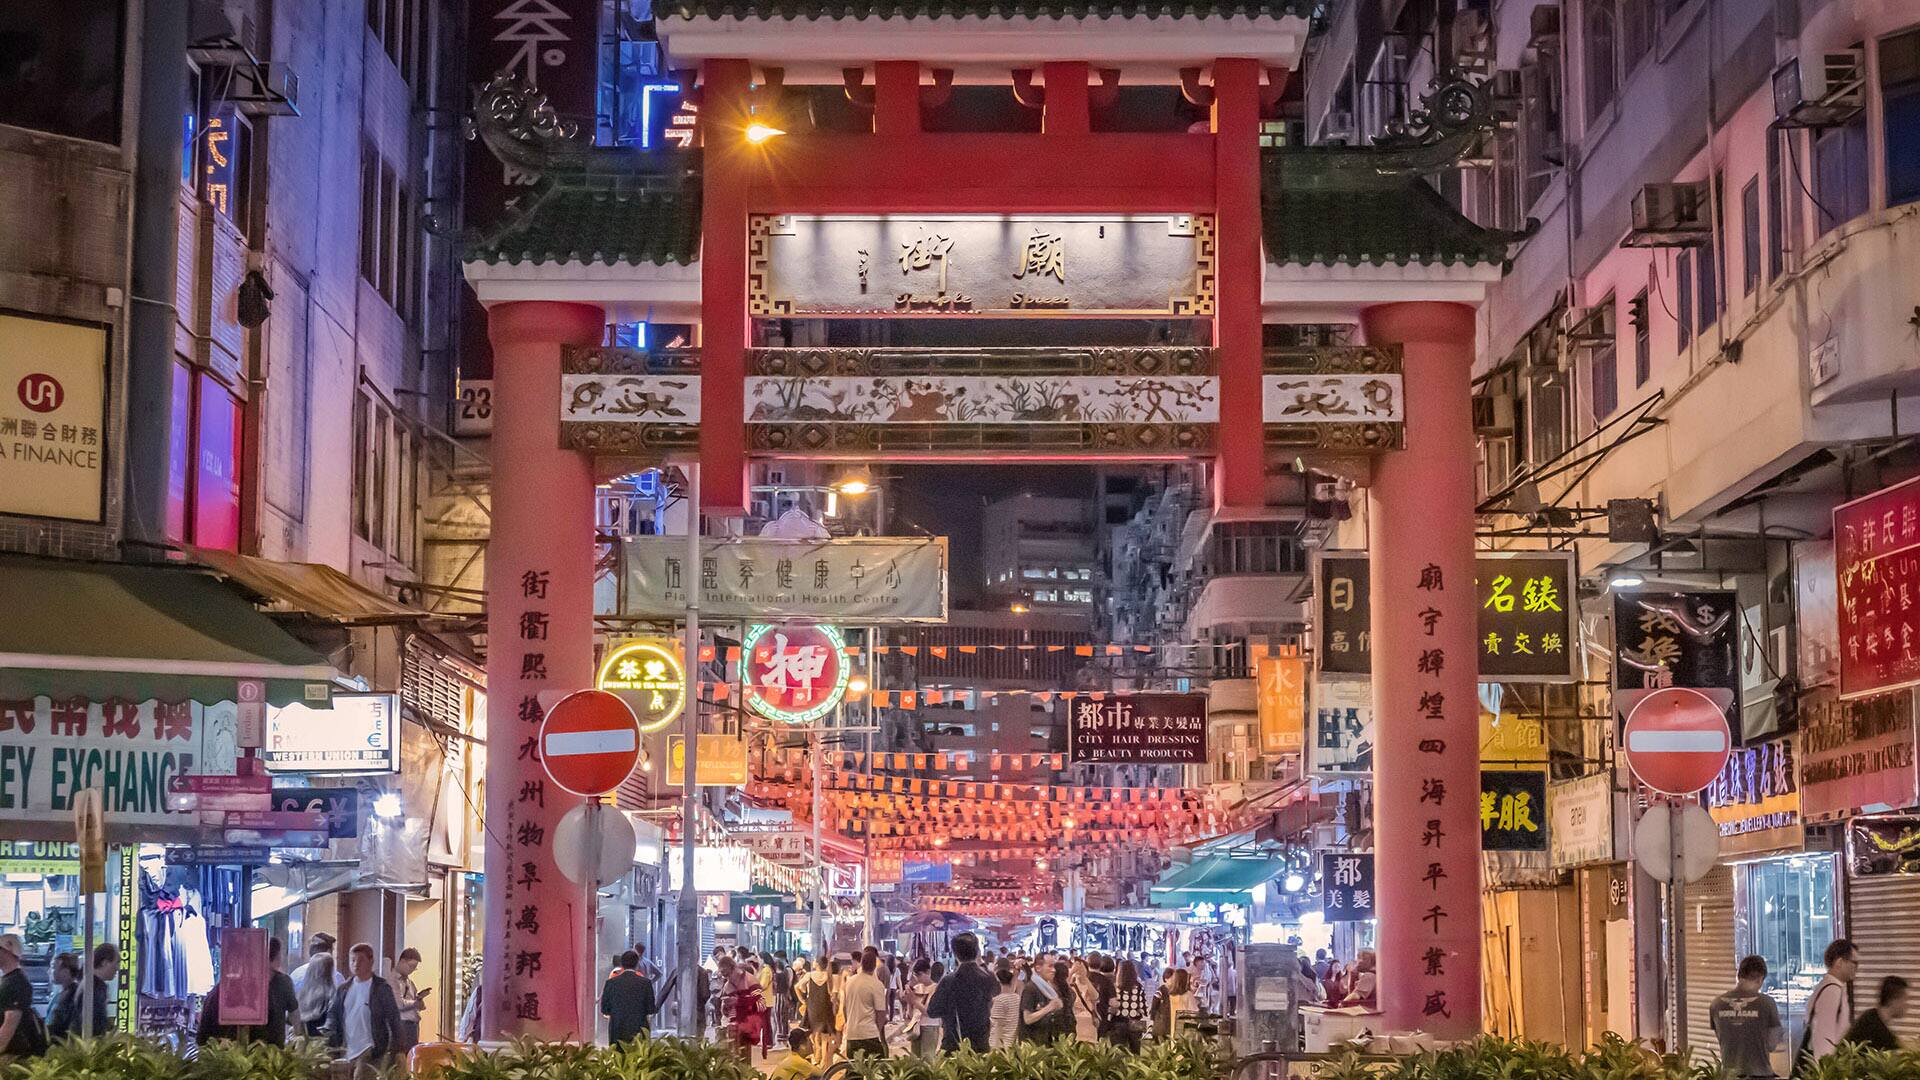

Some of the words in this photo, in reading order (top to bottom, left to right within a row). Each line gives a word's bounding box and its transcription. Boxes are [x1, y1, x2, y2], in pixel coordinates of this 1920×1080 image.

[896, 293, 972, 309] Temple
[1011, 293, 1069, 309] Street
[14, 443, 97, 469] FINANCE
[706, 592, 795, 603] International
[803, 594, 847, 604] Health
[853, 594, 898, 604] Centre
[760, 633, 829, 701] 押
[1078, 702, 1132, 731] 都市
[1112, 735, 1140, 744] HAIR
[1148, 735, 1200, 744] DRESSING
[324, 751, 359, 760] UNION
[1078, 749, 1086, 758] &
[1093, 749, 1132, 758] BEAUTY
[1140, 749, 1194, 758] PRODUCTS
[120, 846, 133, 916] WESTERN
[1333, 857, 1362, 888] 都
[1327, 889, 1372, 909] 美髮
[119, 920, 131, 971] UNION
[117, 988, 130, 1032] MONE
[1738, 1010, 1759, 1018] AGAIN
